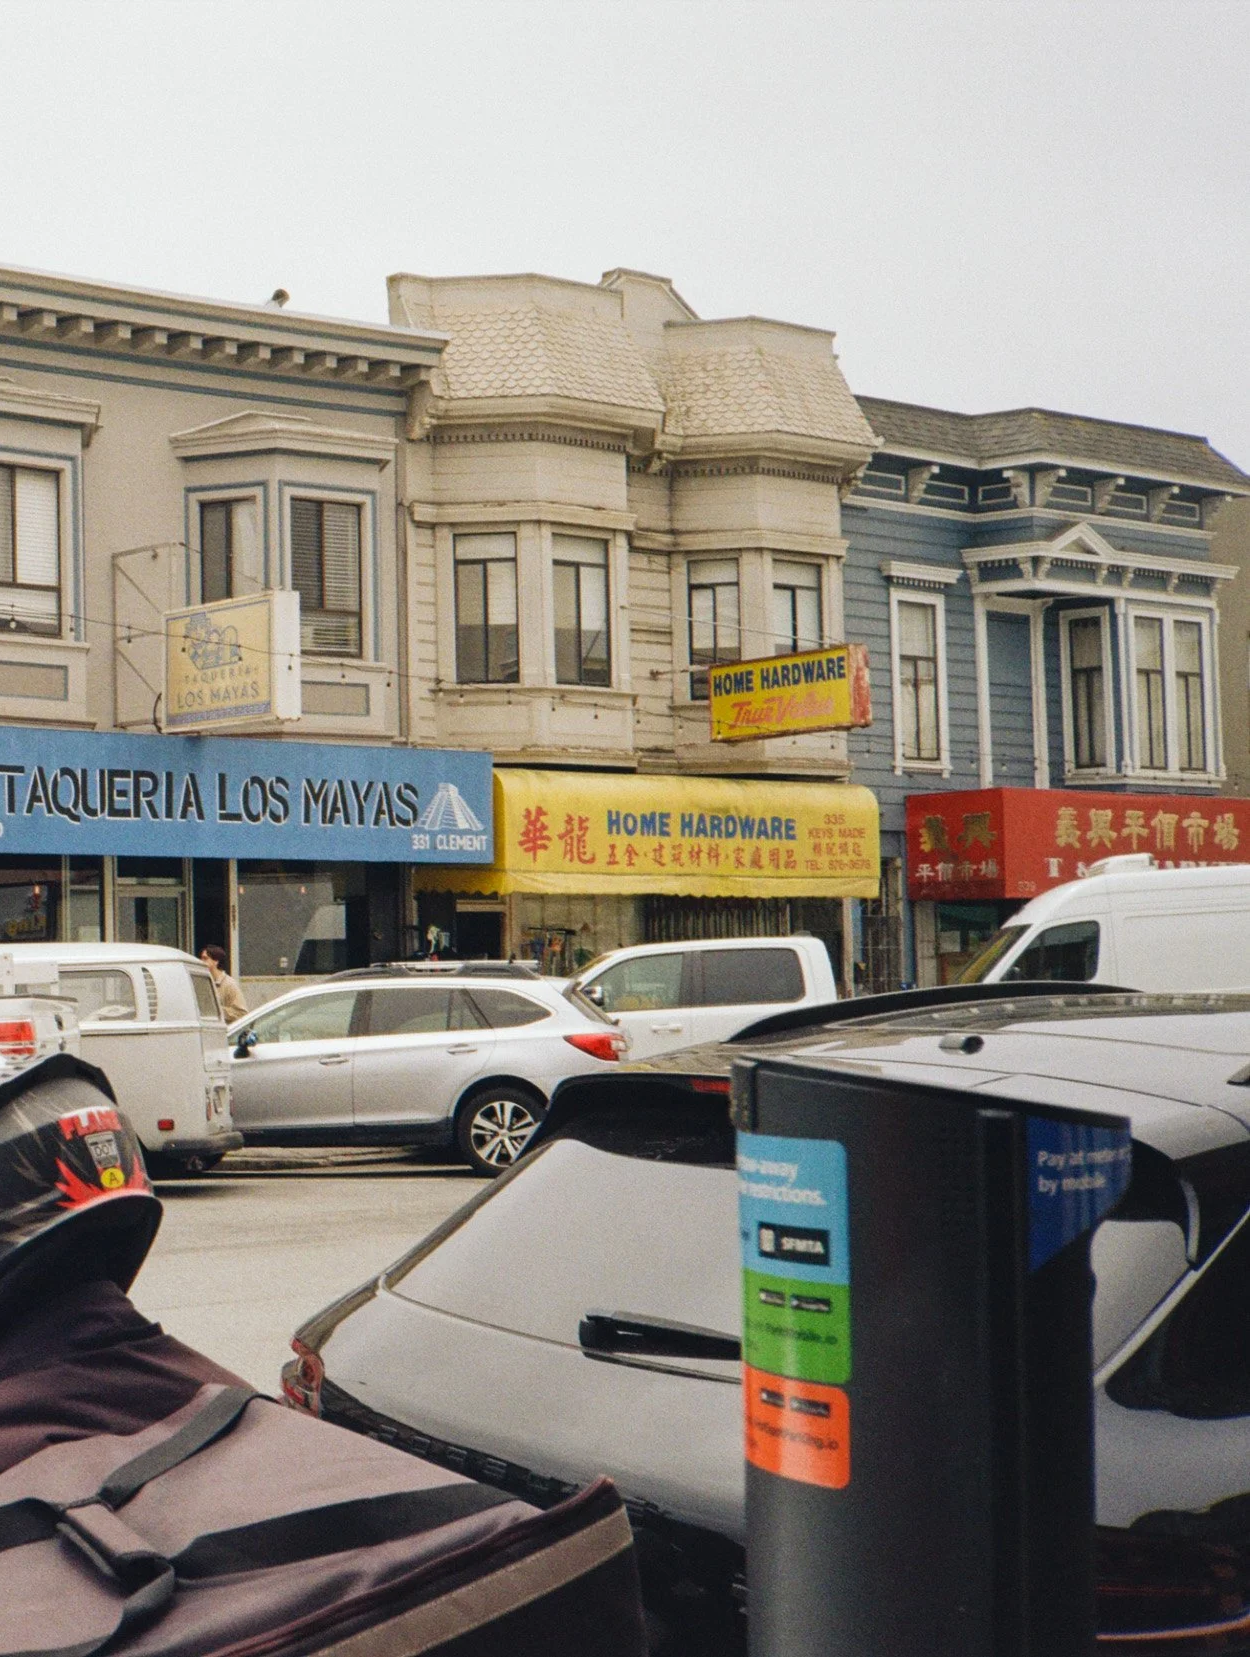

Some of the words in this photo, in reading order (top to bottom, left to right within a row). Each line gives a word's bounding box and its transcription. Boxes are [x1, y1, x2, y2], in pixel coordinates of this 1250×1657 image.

[713, 670, 754, 697] HOME
[760, 656, 846, 690] HARDWARE
[177, 689, 204, 709] LOS
[210, 681, 259, 703] MAYAS
[215, 772, 290, 825] LOS
[302, 778, 420, 828] MAYAS
[606, 809, 671, 837] HOME
[680, 812, 797, 840] HARDWARE
[823, 813, 846, 825] 335
[411, 834, 430, 849] 331
[437, 834, 487, 851] CLEMENT
[518, 805, 596, 865] 華龍
[807, 827, 834, 839] KEYS
[838, 827, 865, 839] MADE
[1045, 857, 1062, 877] T
[1037, 1150, 1066, 1170] Pay
[108, 1171, 118, 1184] A
[1037, 1175, 1059, 1196] by
